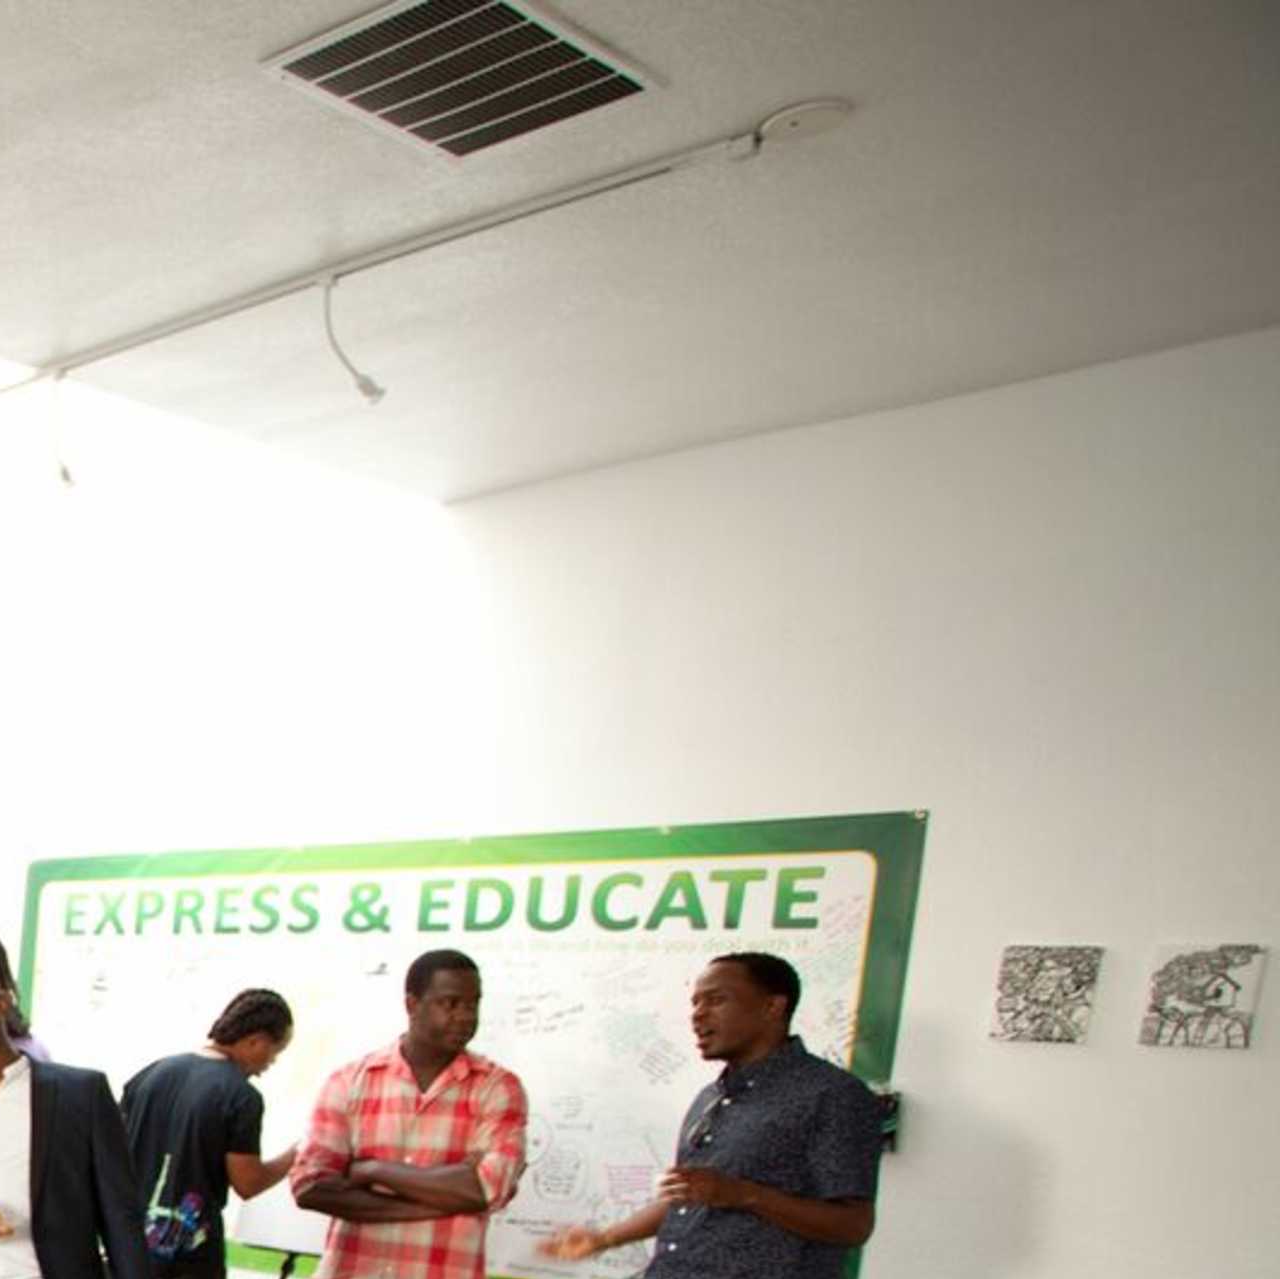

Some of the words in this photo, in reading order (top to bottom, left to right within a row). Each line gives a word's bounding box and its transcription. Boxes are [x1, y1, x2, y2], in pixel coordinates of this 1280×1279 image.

[63, 882, 320, 935] EXPRESS
[342, 881, 391, 934] &
[417, 866, 827, 932] EDUCATE
